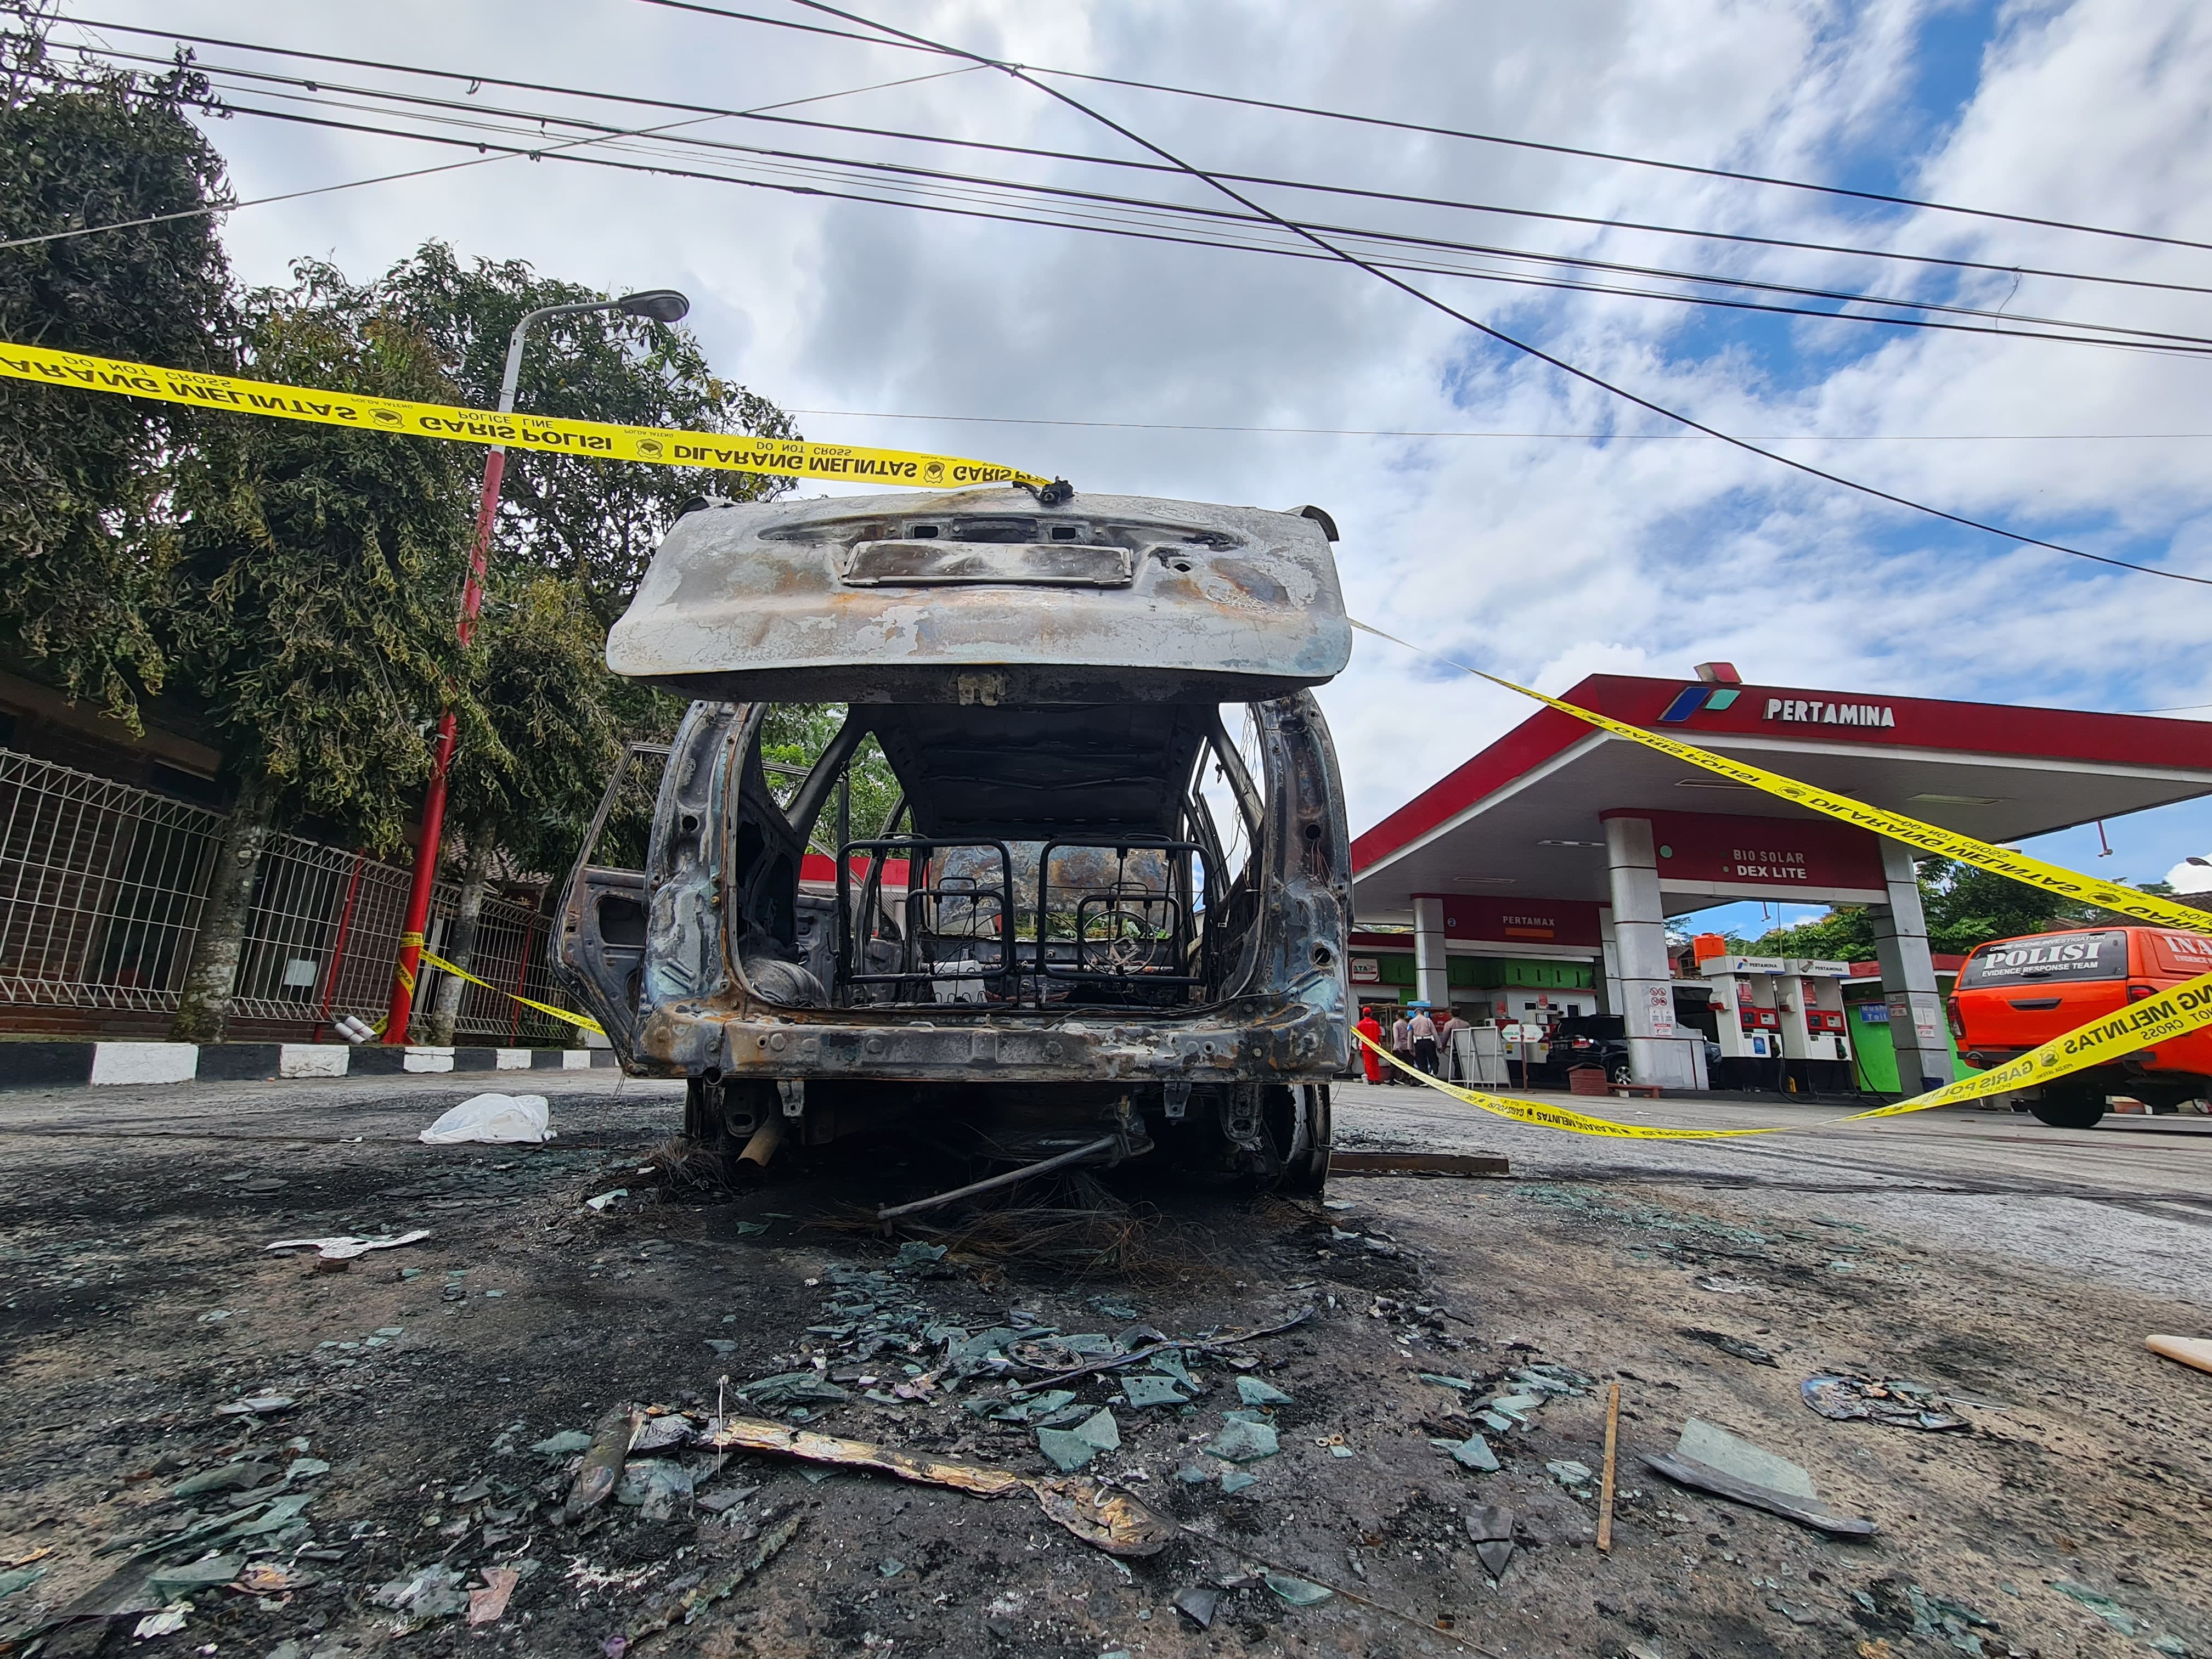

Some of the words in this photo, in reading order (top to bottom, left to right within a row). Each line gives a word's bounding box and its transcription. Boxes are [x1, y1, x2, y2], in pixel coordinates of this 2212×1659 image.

[1766, 698, 1895, 727] PERTAMINA
[1733, 849, 1755, 861] BIO
[1760, 851, 1805, 864] SOLAR
[1737, 865, 1769, 877] DEX
[1772, 867, 1807, 879] LITE
[1503, 916, 1555, 926] PERTAMAX
[2042, 934, 2106, 946] INVESTIGATION
[2162, 936, 2212, 956] INA
[1983, 942, 2102, 969] POLISI
[1982, 967, 2021, 977] EVIDENCE
[2022, 964, 2070, 973] RESPONSE
[1537, 1111, 1576, 1127] MELINTAS
